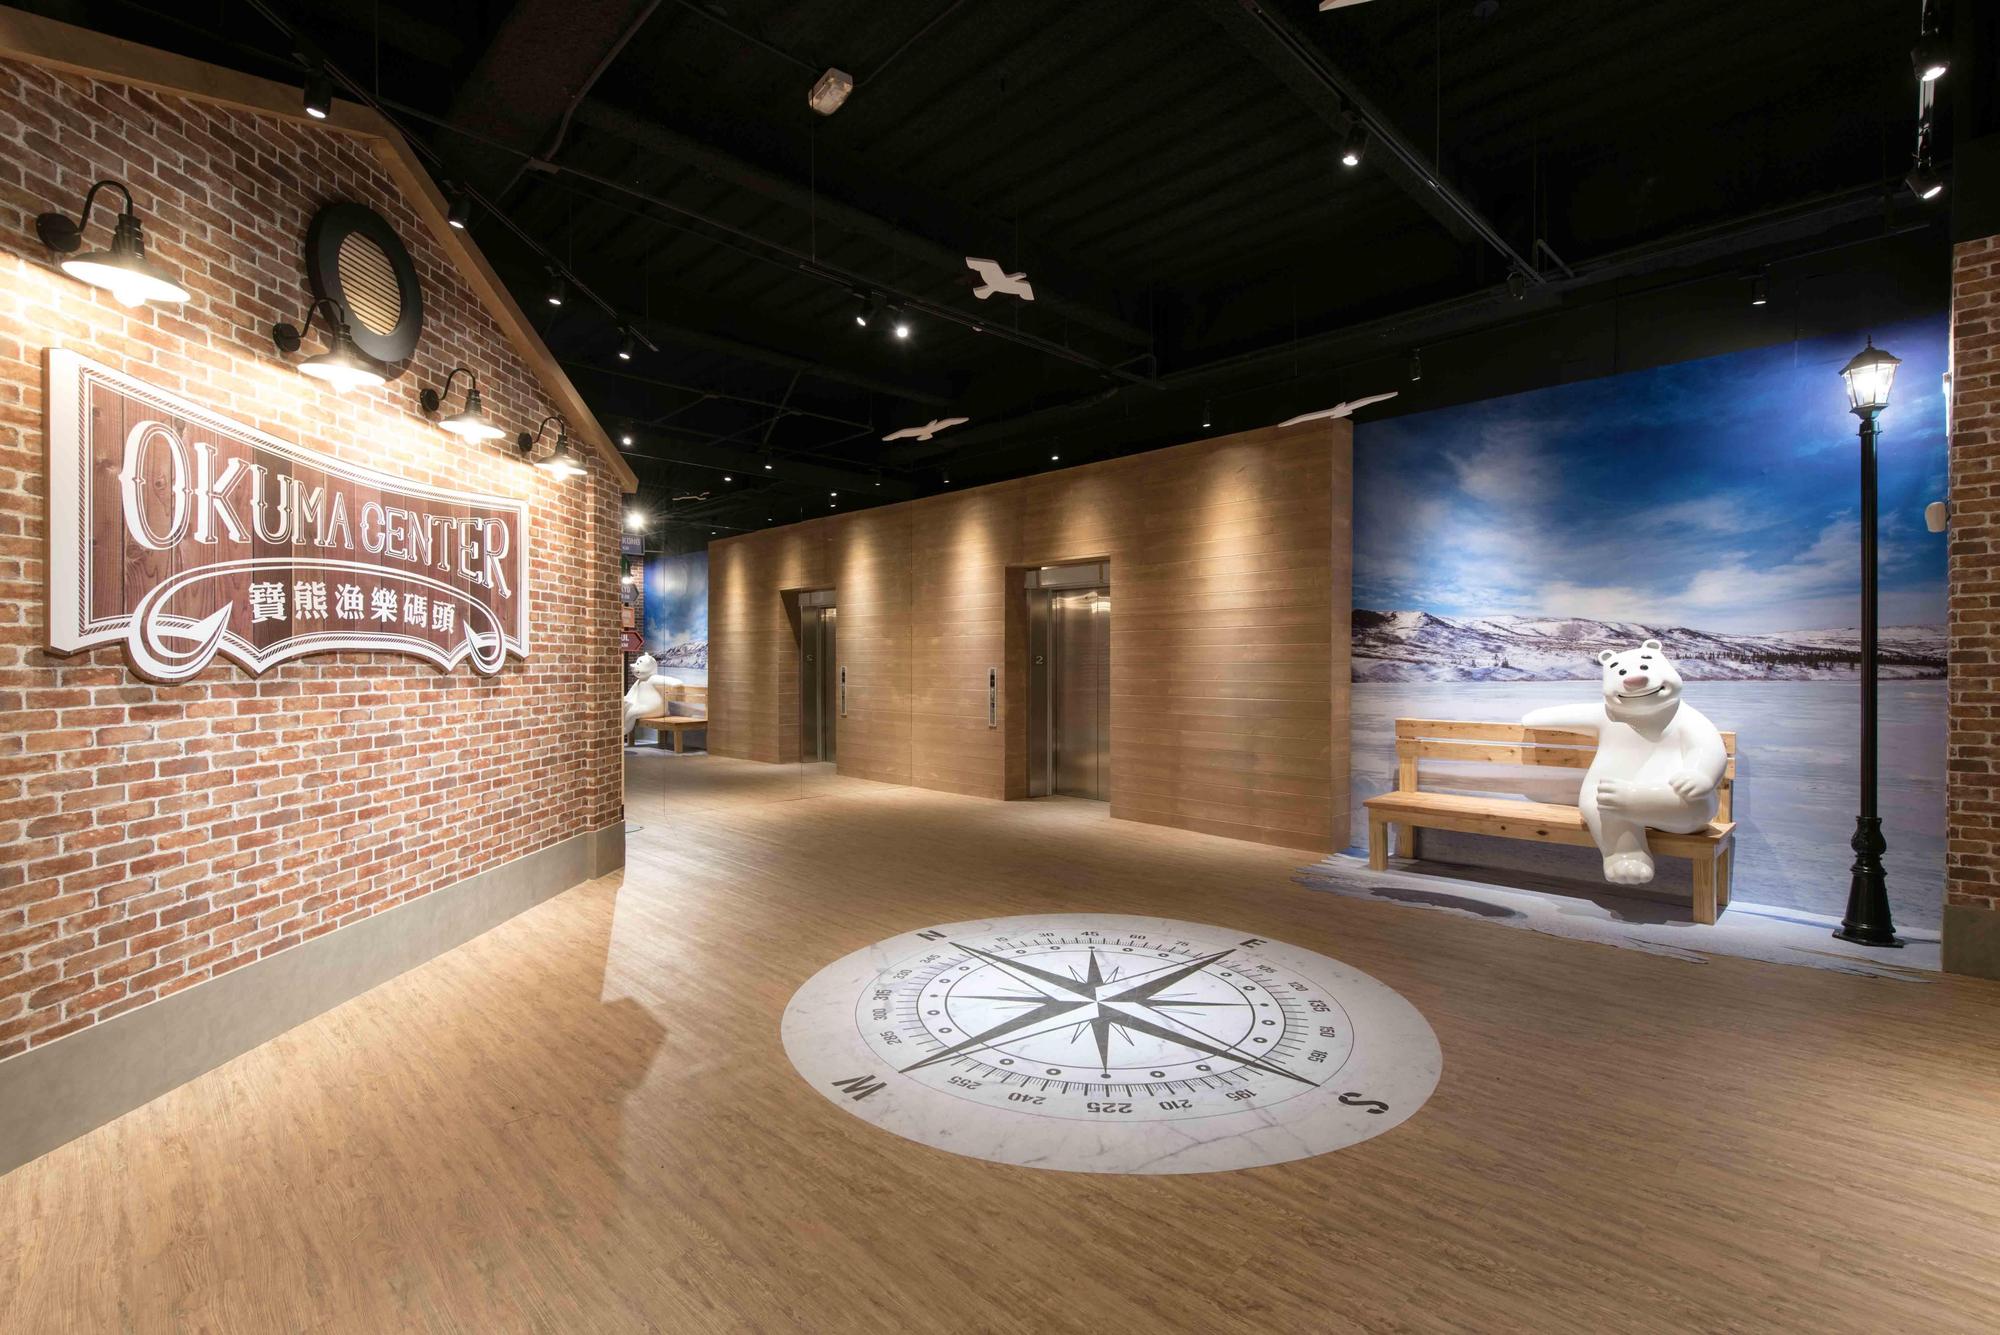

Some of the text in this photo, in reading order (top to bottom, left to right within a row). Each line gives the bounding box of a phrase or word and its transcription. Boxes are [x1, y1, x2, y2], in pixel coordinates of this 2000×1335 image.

[118, 420, 512, 599] OKUMA CENTER
[248, 581, 456, 634] 寶熊漁樂碼頭
[1035, 655, 1044, 665] 2
[916, 930, 947, 941] N
[1240, 938, 1267, 949] E
[1255, 964, 1277, 974] 105
[1288, 981, 1309, 992] 120
[873, 989, 892, 1001] 315
[1308, 999, 1331, 1013] 135
[872, 1008, 888, 1021] 300
[880, 1030, 903, 1046] 285
[1319, 1025, 1336, 1038] 150
[1307, 1049, 1328, 1063] 165
[947, 1075, 983, 1090] 255
[1008, 1092, 1047, 1105] 240
[1225, 1088, 1257, 1102] 195
[1087, 1102, 1133, 1113] 225
[1159, 1099, 1193, 1111] 210
[1338, 1092, 1389, 1114] S
